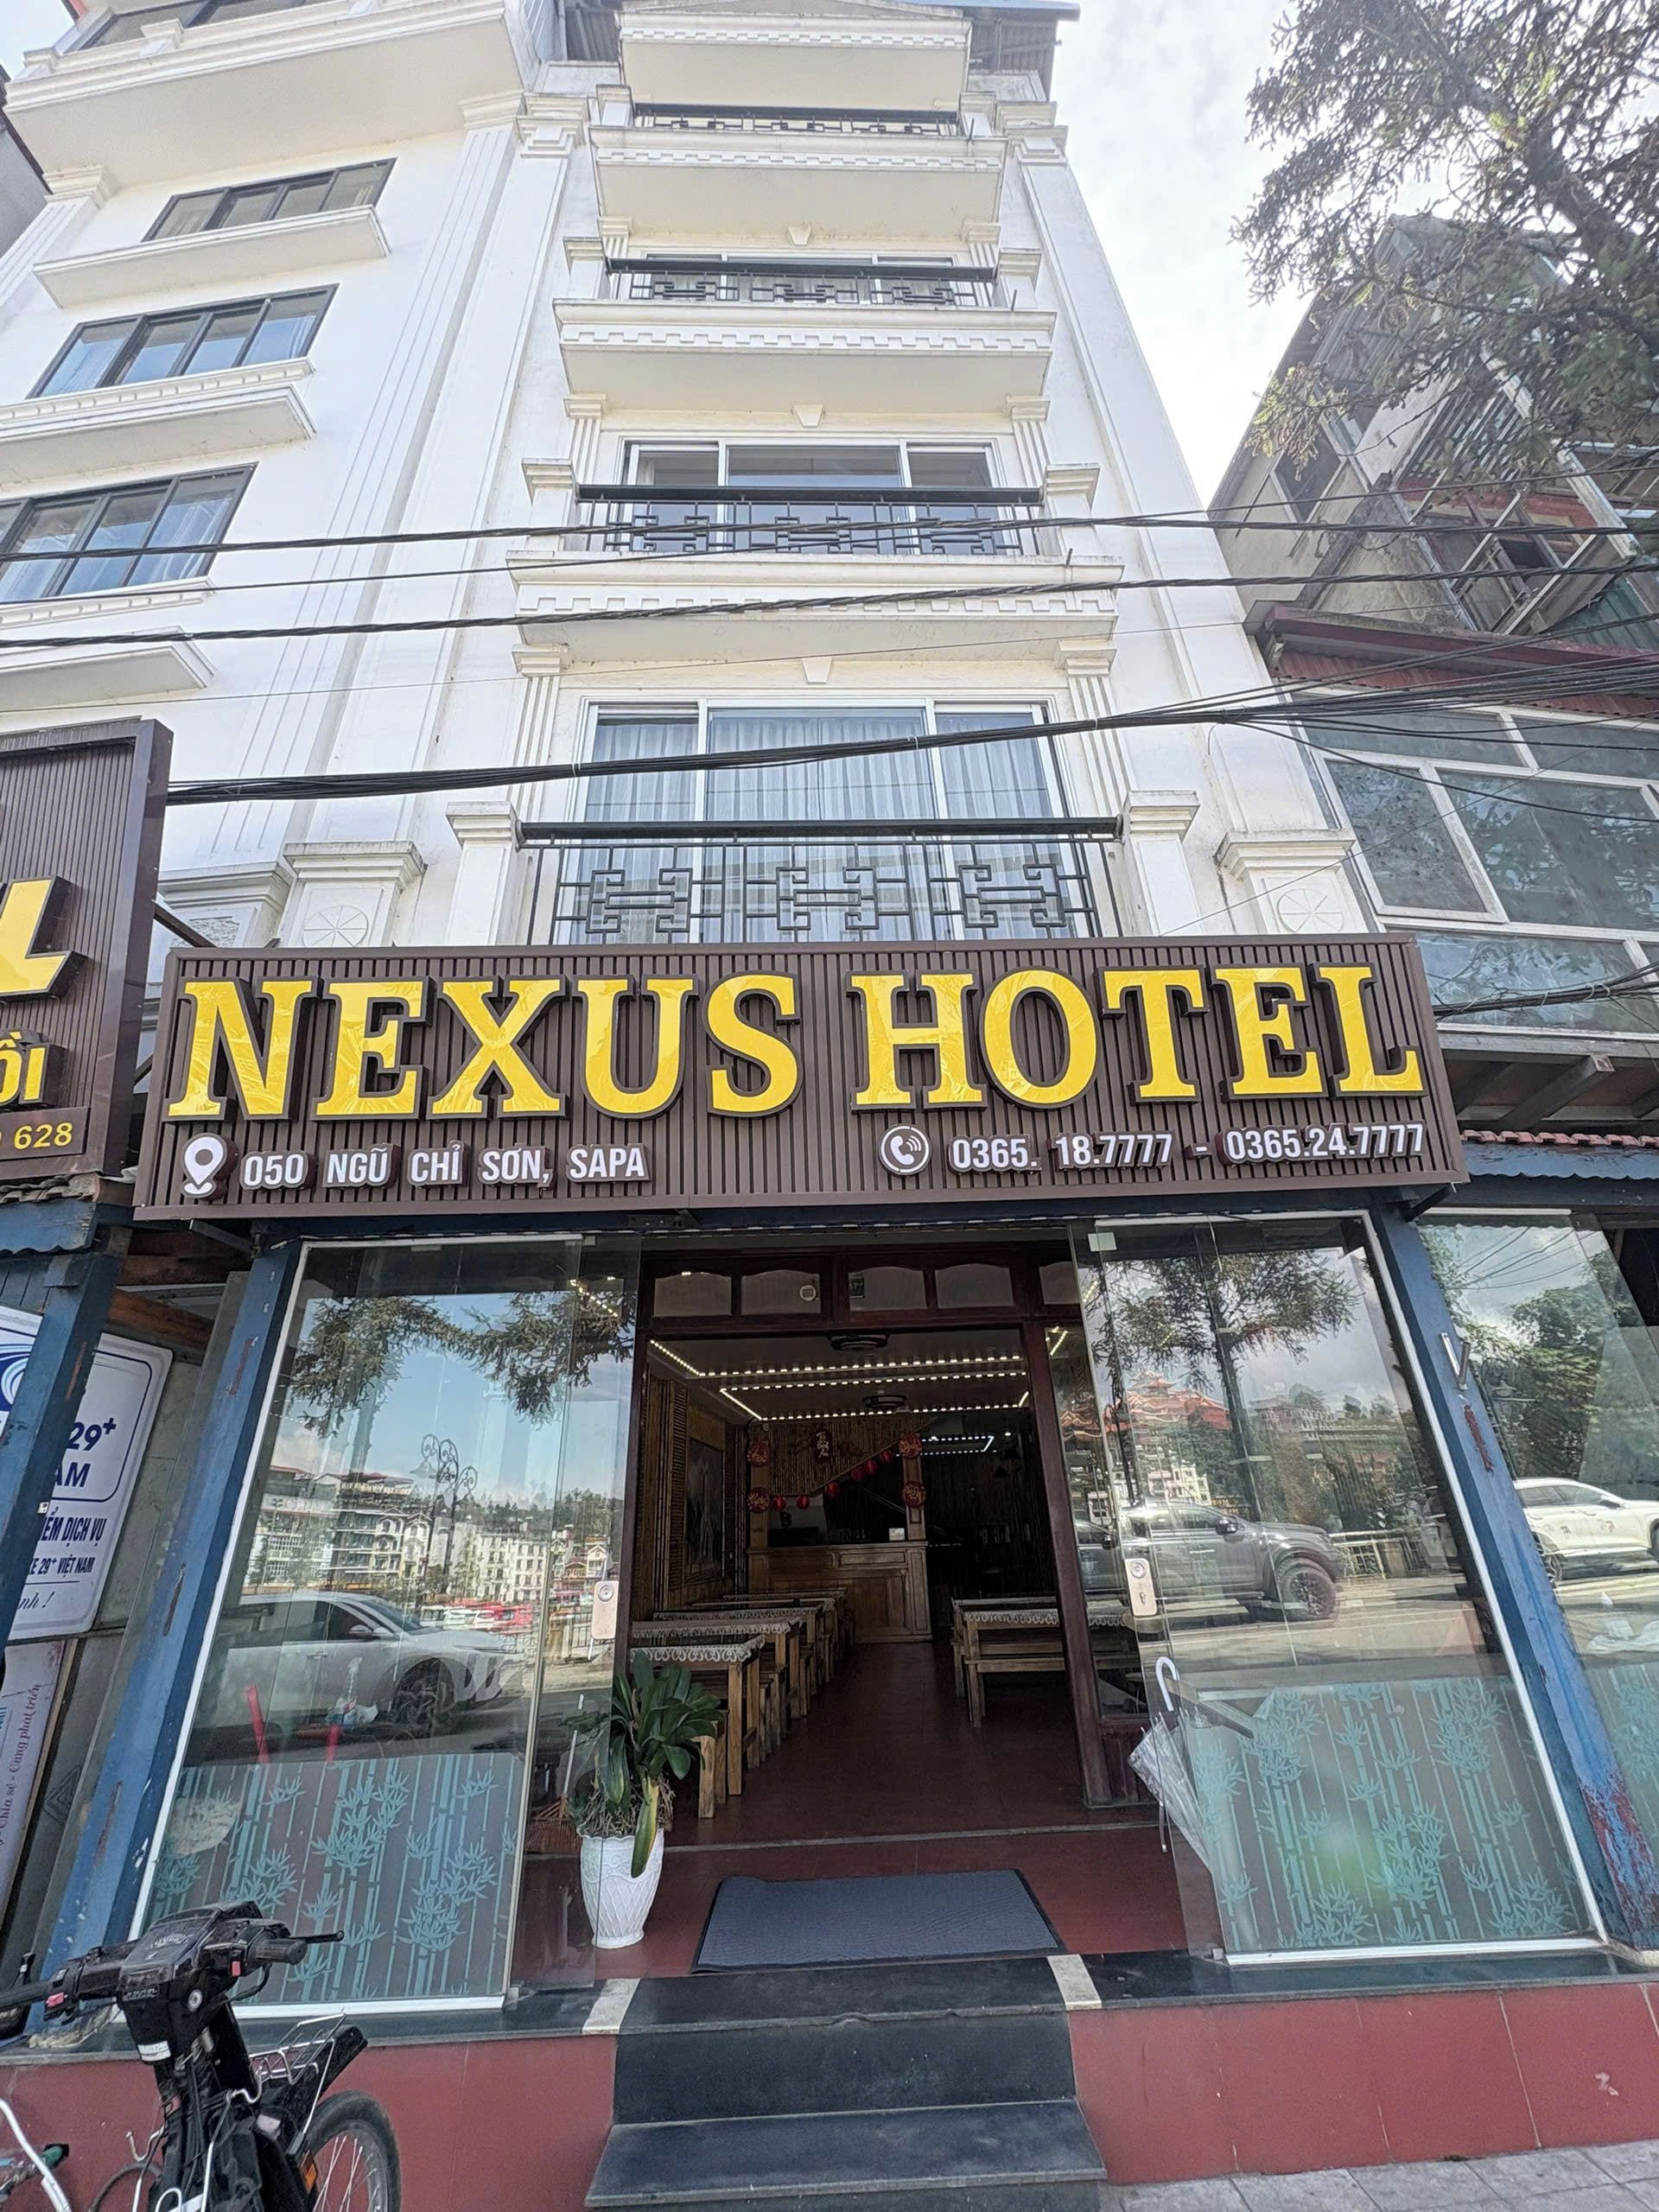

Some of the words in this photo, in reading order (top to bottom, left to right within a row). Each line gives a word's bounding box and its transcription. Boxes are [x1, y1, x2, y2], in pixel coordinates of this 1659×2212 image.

[168, 972, 799, 1117] NEXUS
[851, 963, 1427, 1107] HOTEL
[14, 1122, 73, 1150] 628
[952, 1138, 1038, 1169] 0365.
[1056, 1134, 1173, 1166] 18.7777
[1227, 1123, 1424, 1160] 0365.24.7777
[244, 1154, 304, 1186] 050
[327, 1147, 388, 1184] NGŨ
[411, 1144, 461, 1183] CHỈ
[482, 1147, 550, 1184] SƠN,
[570, 1147, 645, 1179] SAPA
